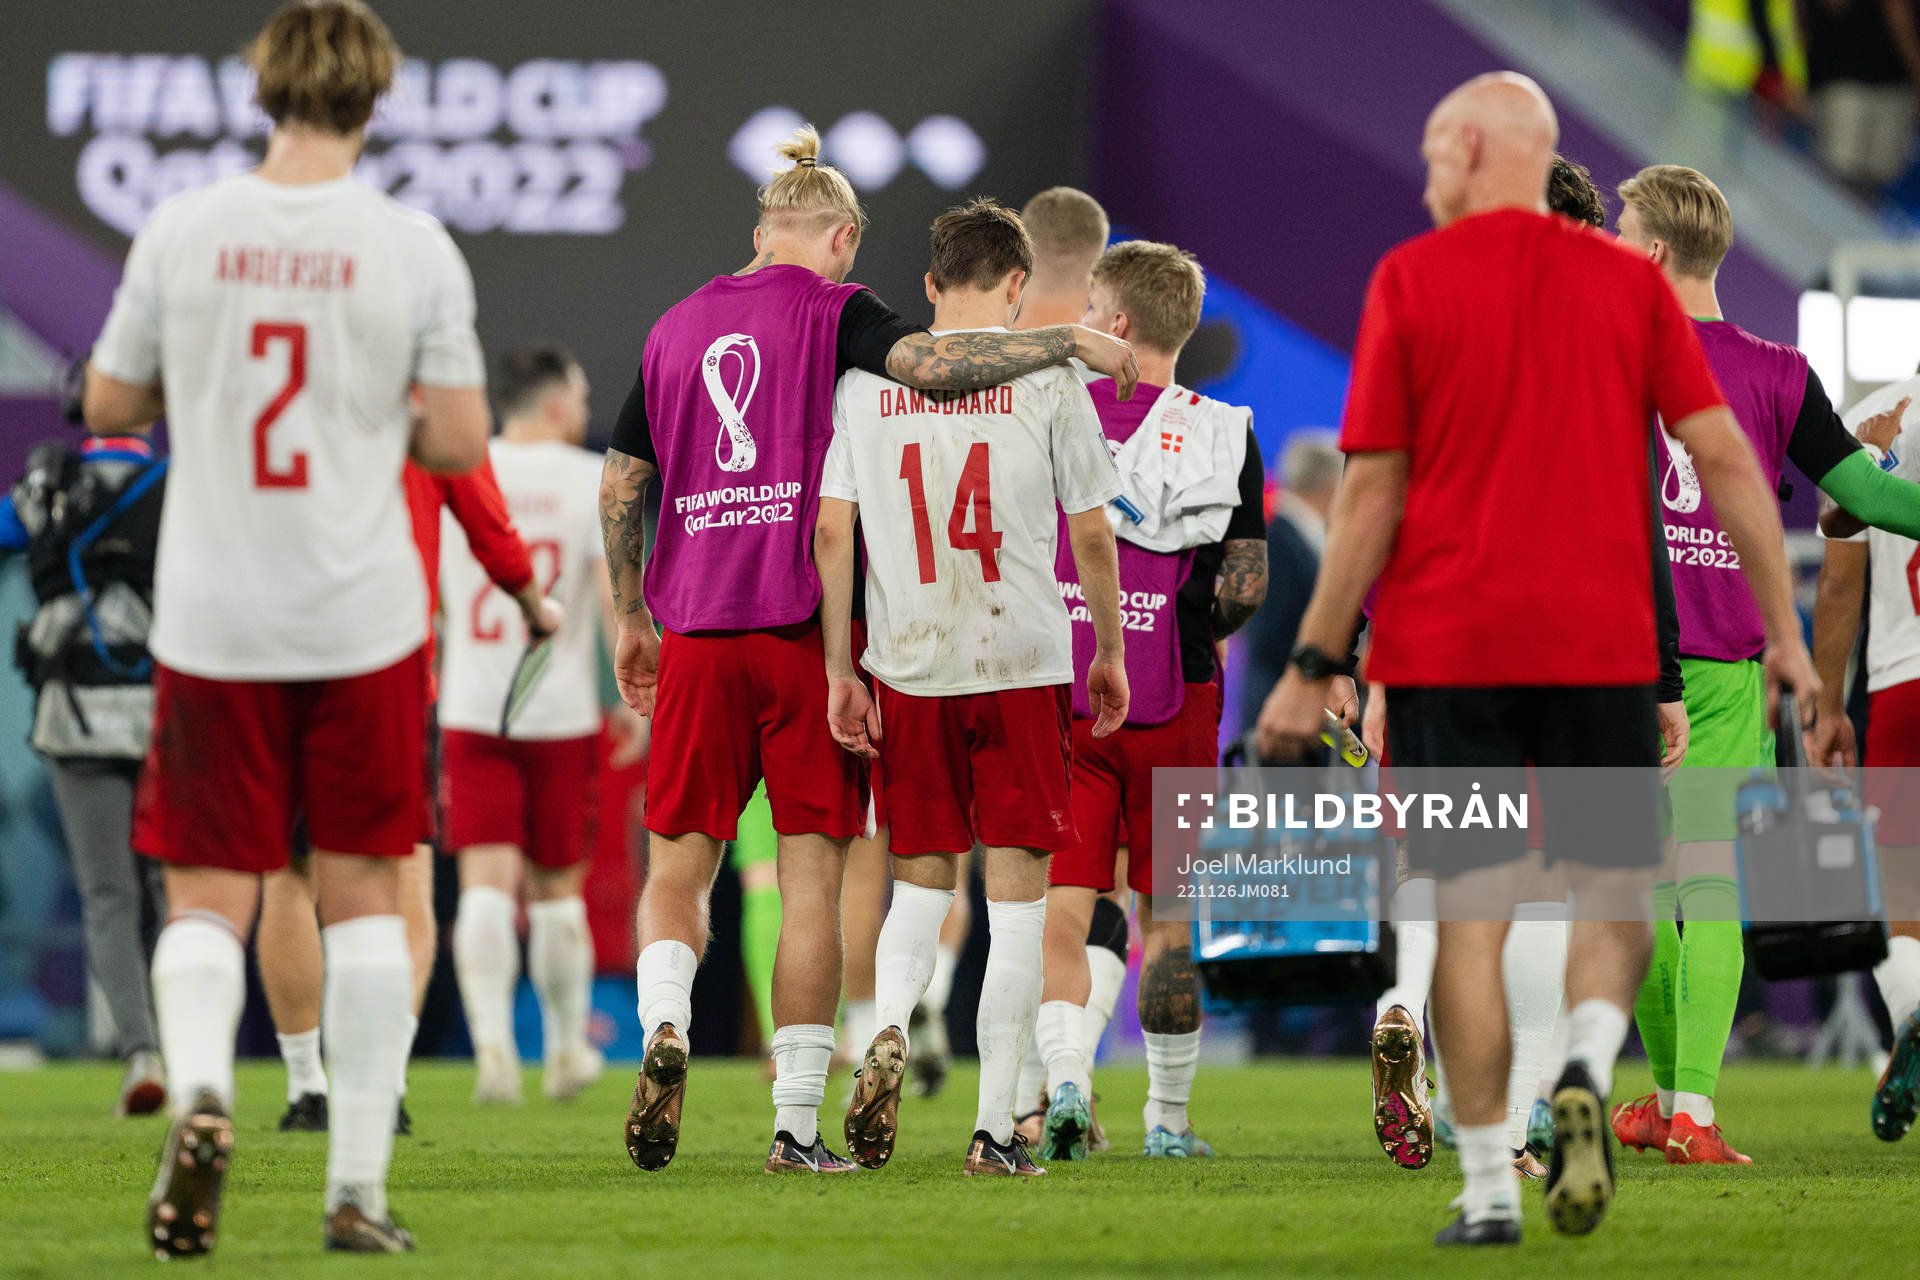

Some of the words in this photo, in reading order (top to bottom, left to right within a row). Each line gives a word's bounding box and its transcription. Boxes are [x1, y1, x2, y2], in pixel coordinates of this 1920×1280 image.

[507, 58, 666, 142] CUP
[214, 244, 357, 292] ANDERSEN
[250, 322, 308, 488] 2
[675, 493, 705, 514] FIFA
[706, 485, 774, 507] WORLD
[774, 482, 801, 500] CUP
[899, 442, 1003, 584] 14
[1664, 525, 1714, 545] ORLD
[1130, 592, 1167, 611] CUP
